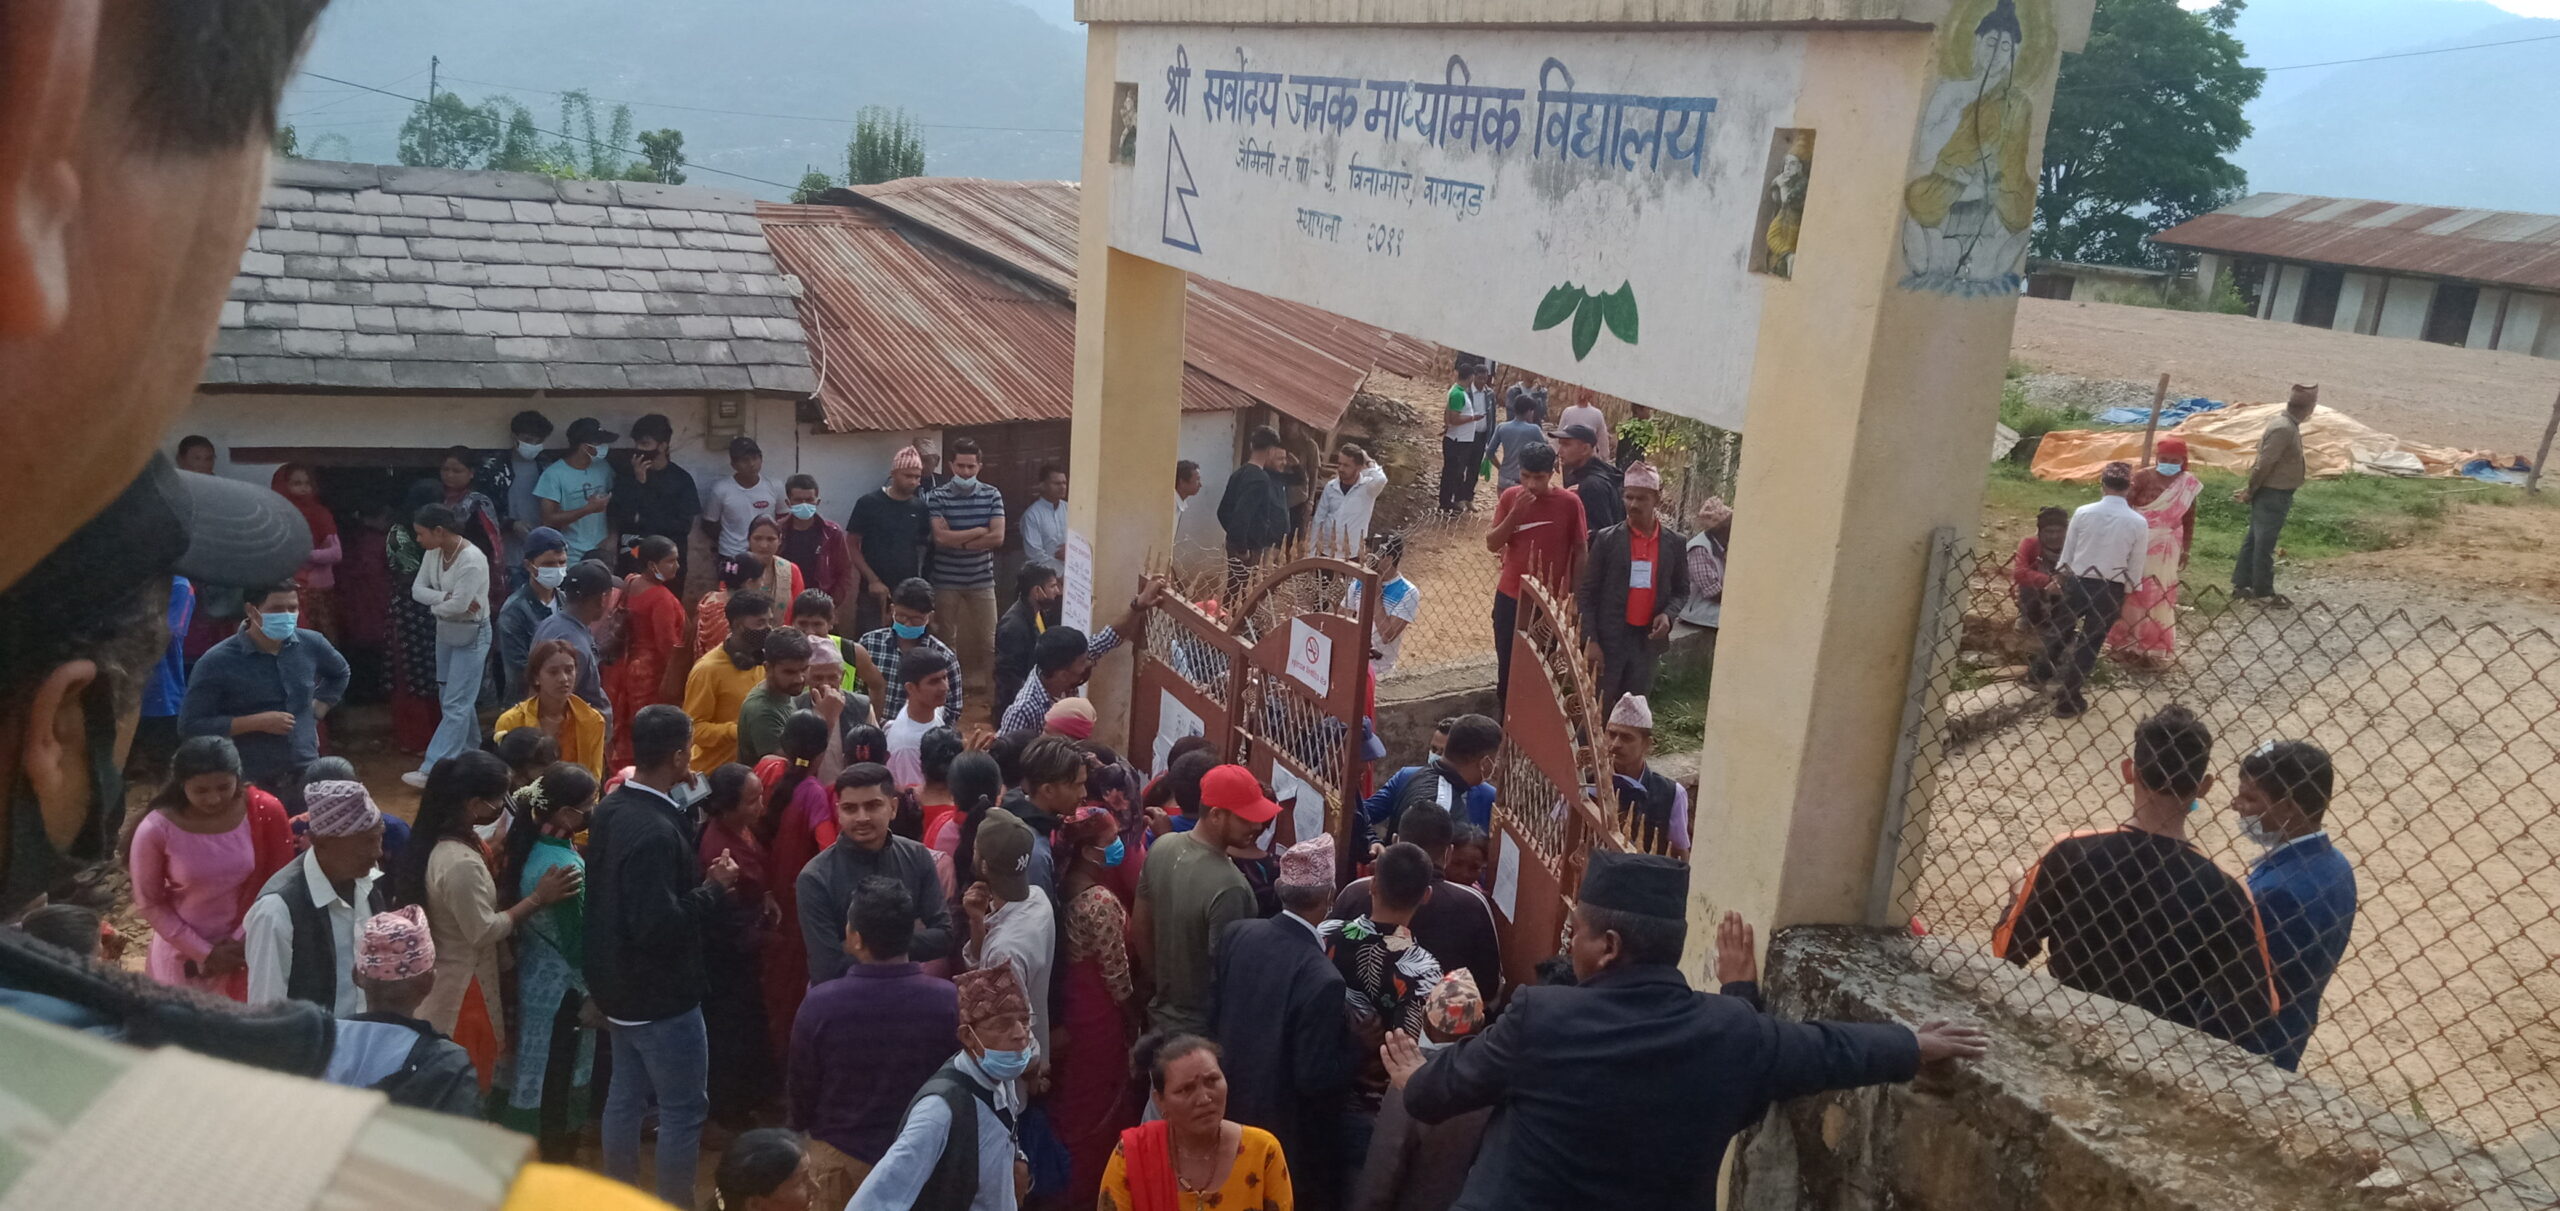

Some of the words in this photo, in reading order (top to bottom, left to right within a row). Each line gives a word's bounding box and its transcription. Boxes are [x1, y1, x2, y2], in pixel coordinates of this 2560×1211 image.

[1165, 44, 1191, 118] श्री
[1204, 46, 1283, 129] सर्वोदय
[1286, 75, 1361, 137] जनक
[1364, 54, 1525, 155] माध्यमिक
[1534, 57, 1717, 177] विद्यालय
[1297, 207, 1342, 243] स्थापना
[1367, 222, 1404, 257] २०११
